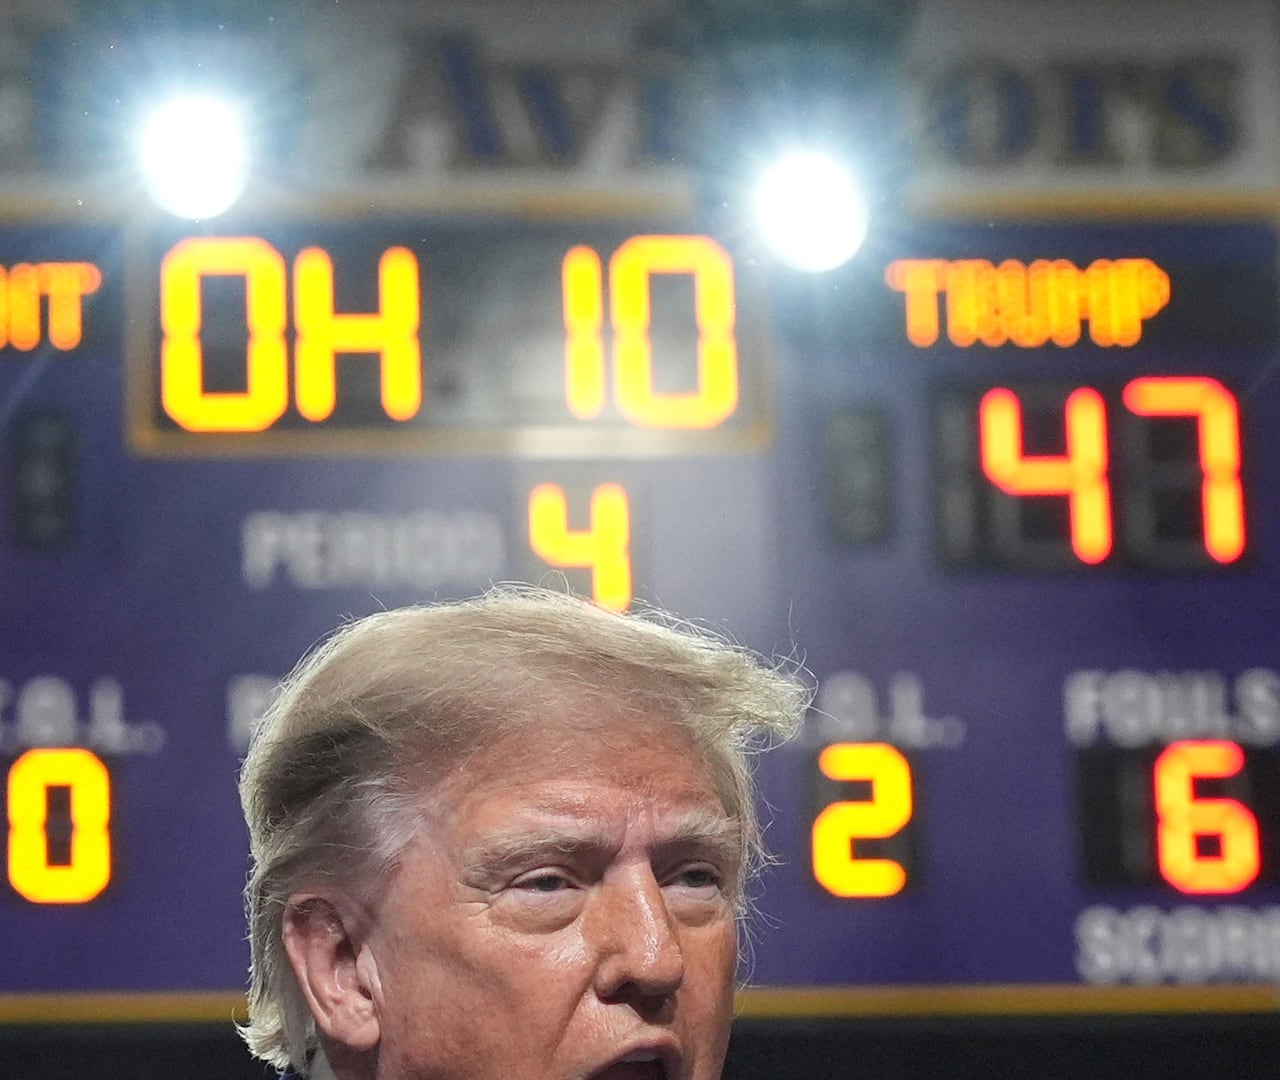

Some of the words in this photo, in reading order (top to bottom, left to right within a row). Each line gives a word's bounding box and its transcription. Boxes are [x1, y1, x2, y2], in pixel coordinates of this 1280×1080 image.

[886, 259, 1171, 348] TRUMP
[528, 482, 634, 614] 4
[979, 376, 1246, 564] 47
[242, 511, 506, 590] PERIOD
[7, 748, 111, 904] 0
[812, 742, 912, 898] 2
[1154, 739, 1261, 895] 6
